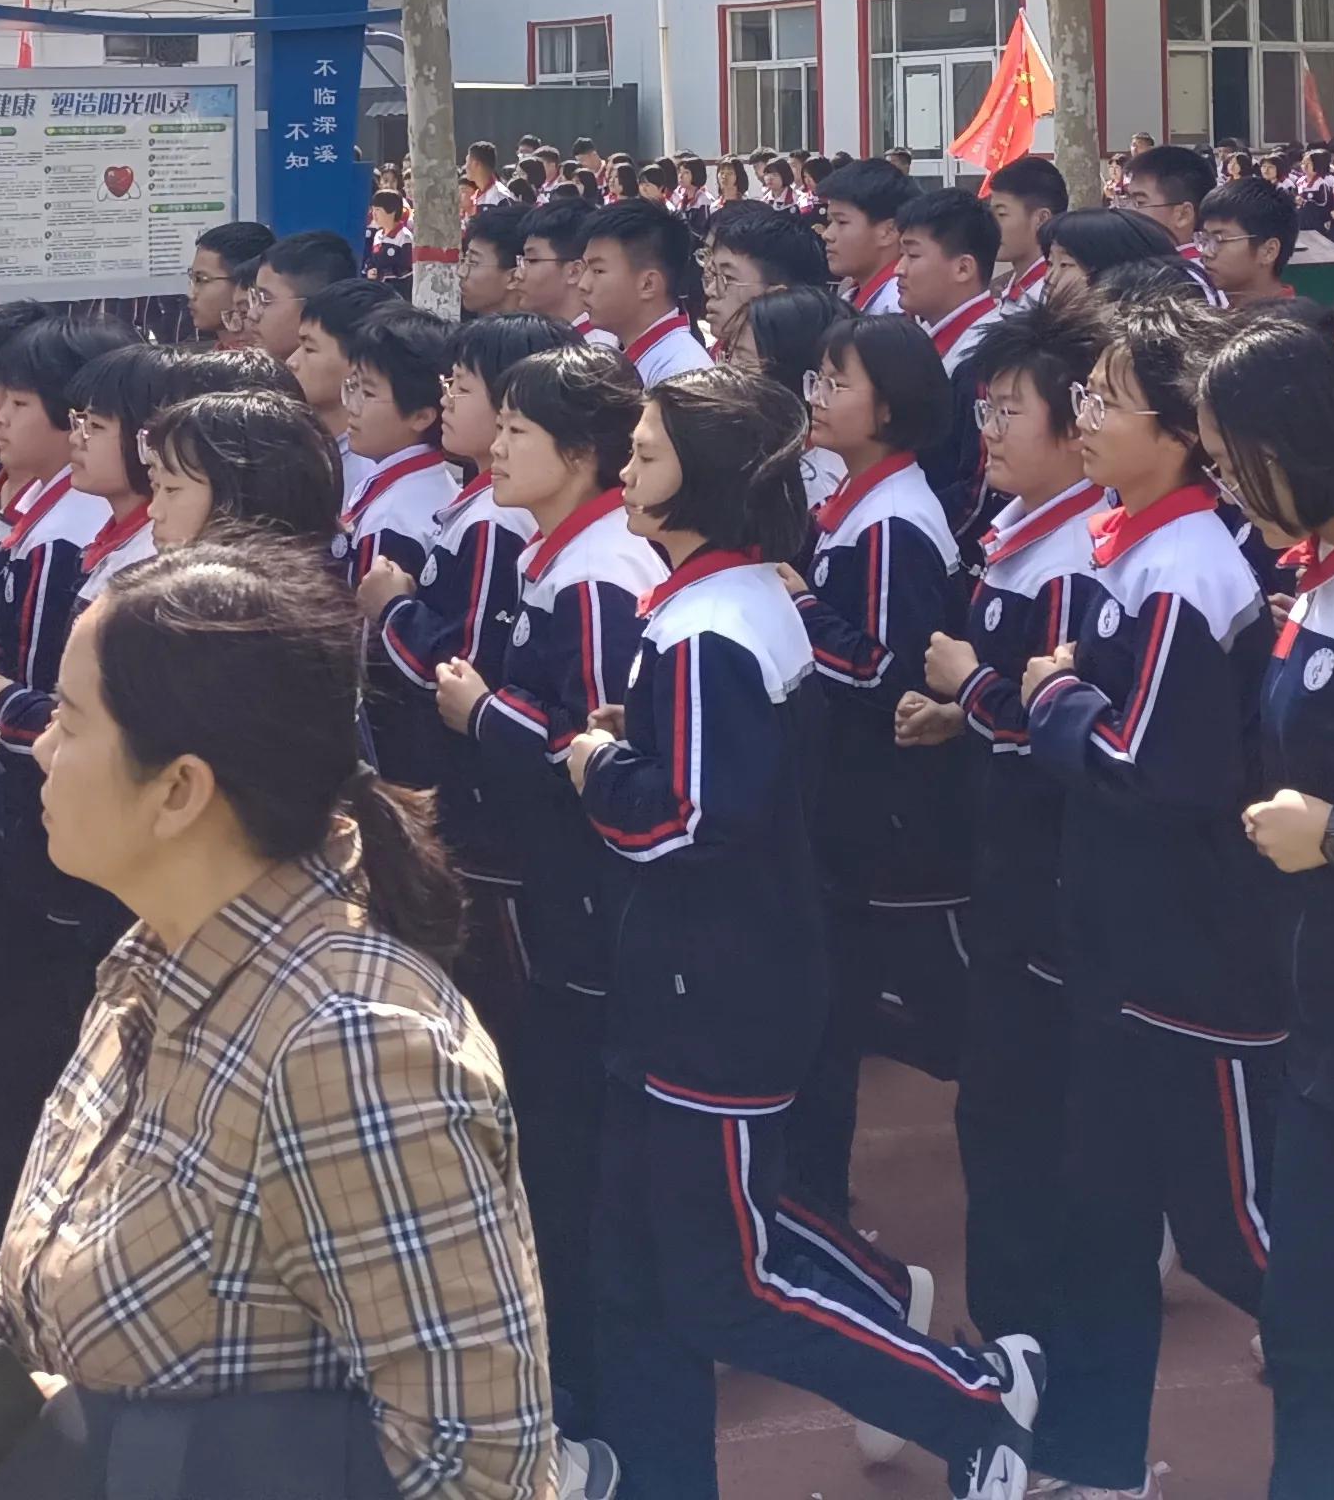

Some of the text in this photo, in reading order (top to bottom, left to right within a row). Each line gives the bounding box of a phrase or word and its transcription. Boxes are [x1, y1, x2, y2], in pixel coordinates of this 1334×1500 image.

[49, 91, 190, 117] 塑造阳光心灵
[312, 59, 338, 163] 不临深溪
[284, 123, 309, 170] 不知
